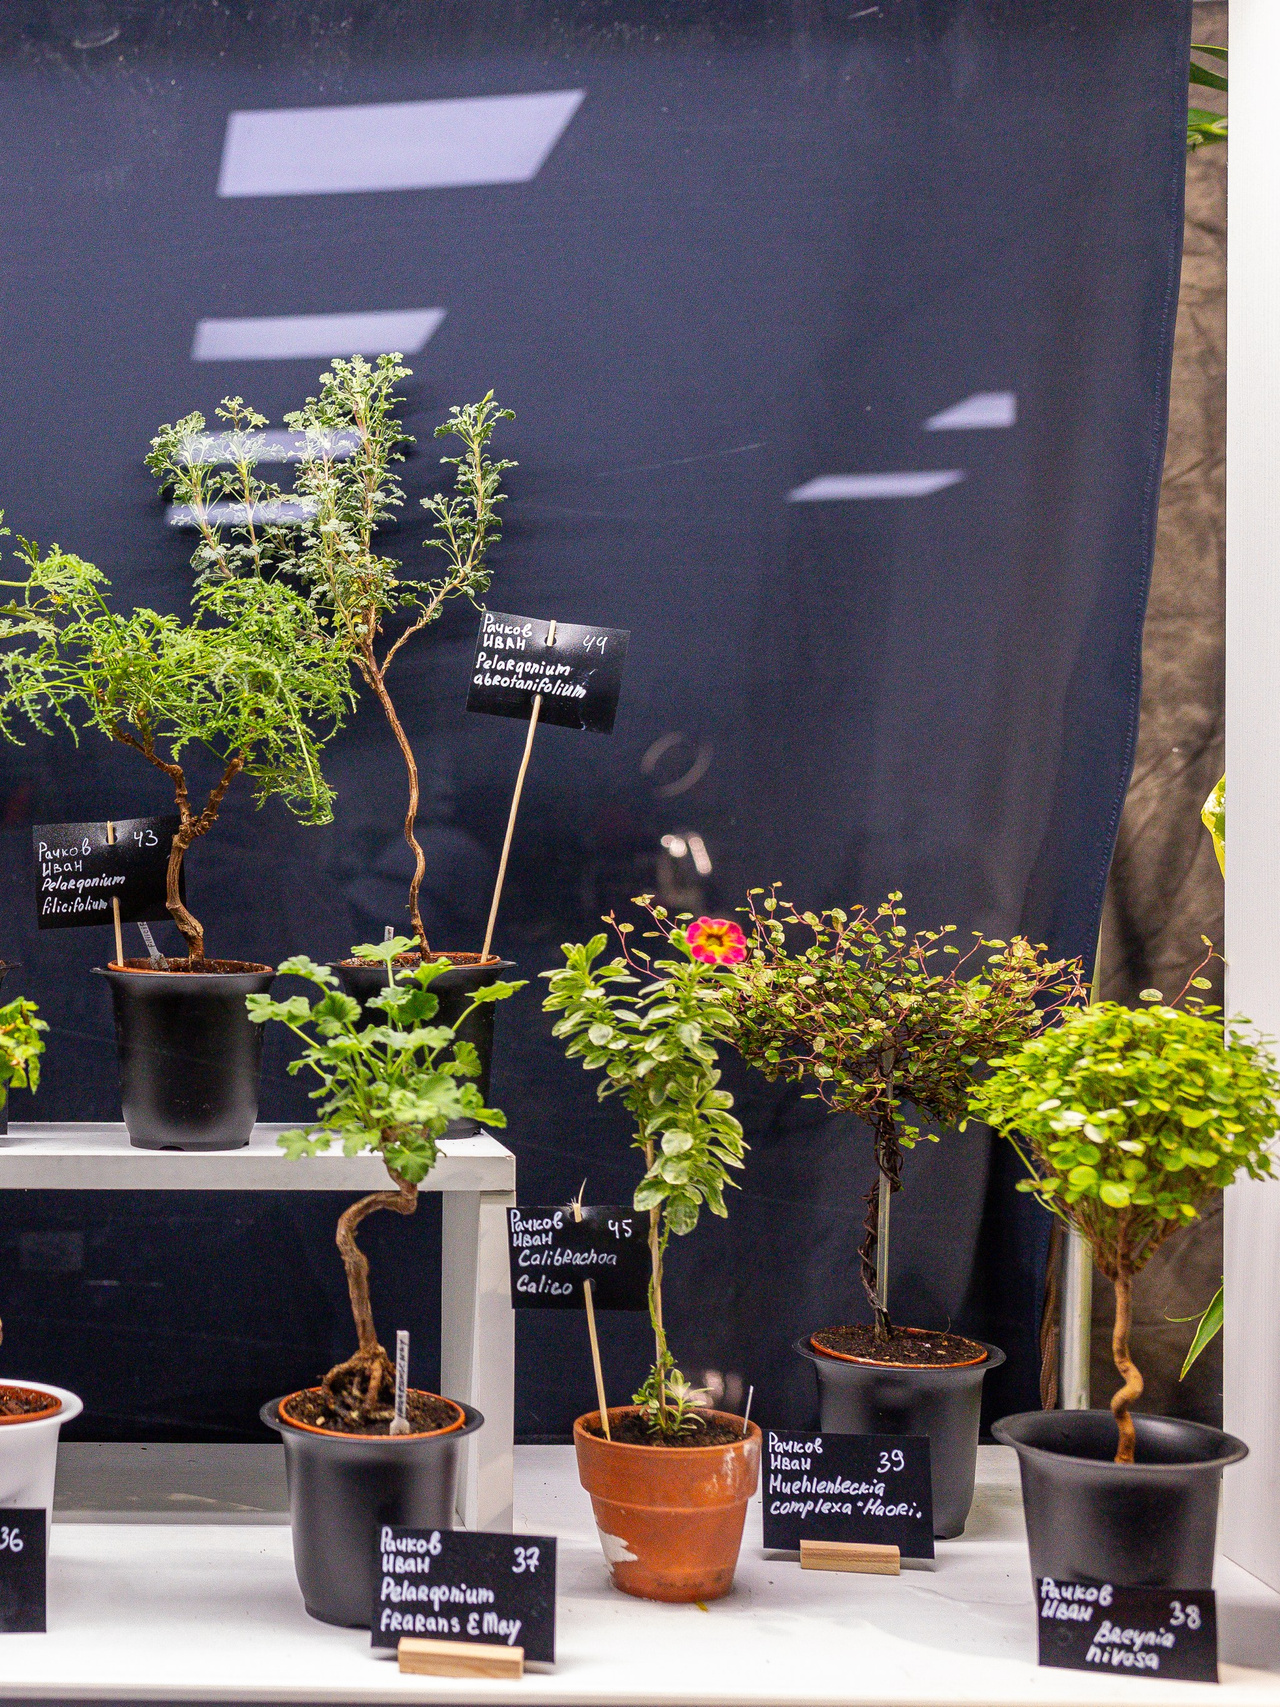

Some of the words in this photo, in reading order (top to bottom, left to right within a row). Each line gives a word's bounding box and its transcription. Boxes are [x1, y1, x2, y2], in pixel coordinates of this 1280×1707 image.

[483, 614, 532, 637] Рачков
[38, 837, 92, 862] Рачков
[133, 829, 158, 847] 43
[42, 859, 83, 877] Иван
[510, 1209, 563, 1232] Рачков
[608, 1219, 632, 1239] 45
[516, 1274, 573, 1295] Calico
[768, 1431, 823, 1454] Рачков
[770, 1454, 812, 1471] Иван
[876, 1449, 905, 1473] 39
[380, 1525, 442, 1556] Рачков
[382, 1553, 431, 1574] Иван
[511, 1546, 541, 1574] 37
[1040, 1576, 1114, 1608] Рачков
[1040, 1599, 1094, 1622] Иван
[1169, 1600, 1202, 1631] 38
